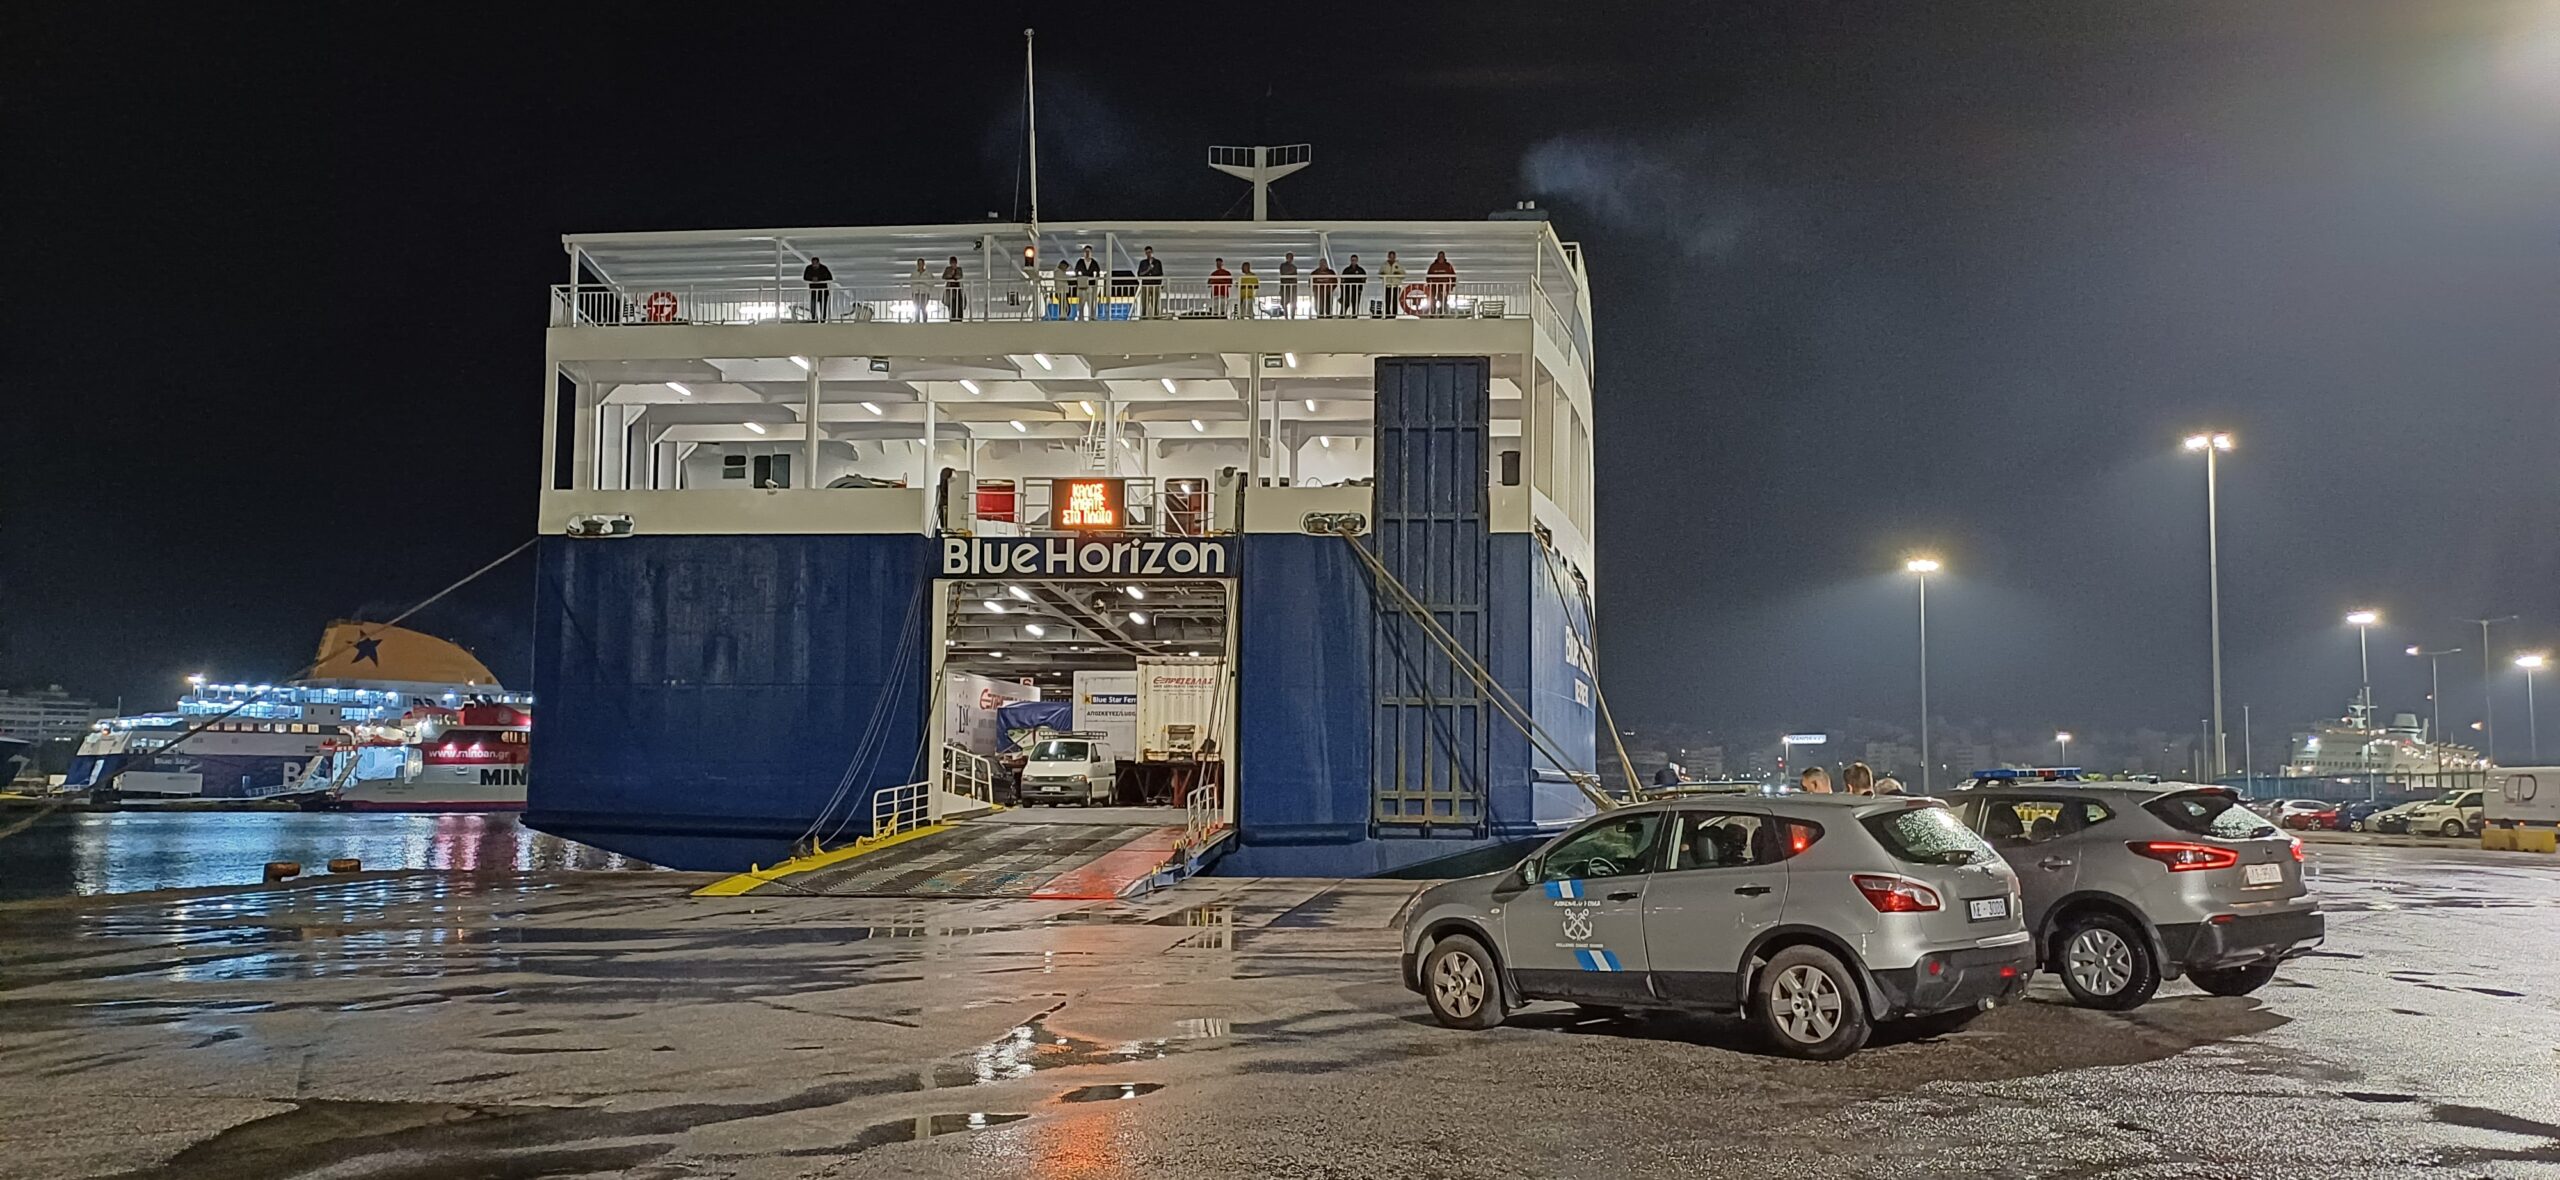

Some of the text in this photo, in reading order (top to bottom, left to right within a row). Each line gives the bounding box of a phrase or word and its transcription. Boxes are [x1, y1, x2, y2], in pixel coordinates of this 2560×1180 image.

[942, 538, 1225, 574] Blue Horizon
[428, 749, 510, 761] www.minoan.gr
